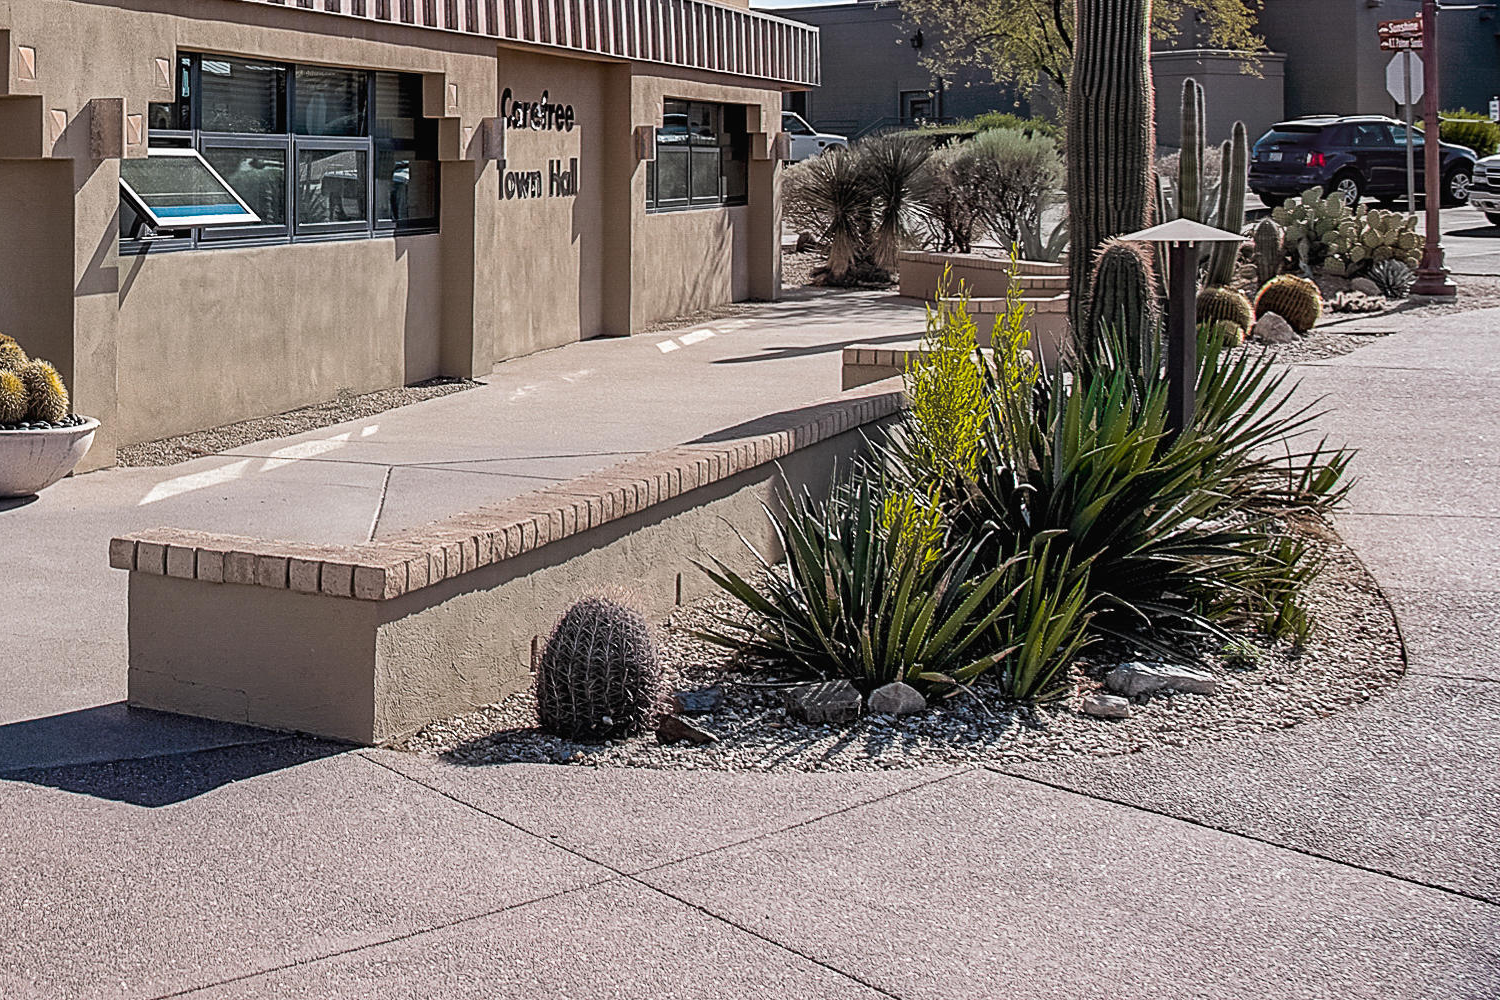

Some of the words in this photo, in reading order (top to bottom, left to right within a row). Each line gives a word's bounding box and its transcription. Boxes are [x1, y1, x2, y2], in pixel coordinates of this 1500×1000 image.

[501, 87, 575, 133] Carefree
[496, 159, 542, 200] Town
[548, 157, 578, 198] Hall
